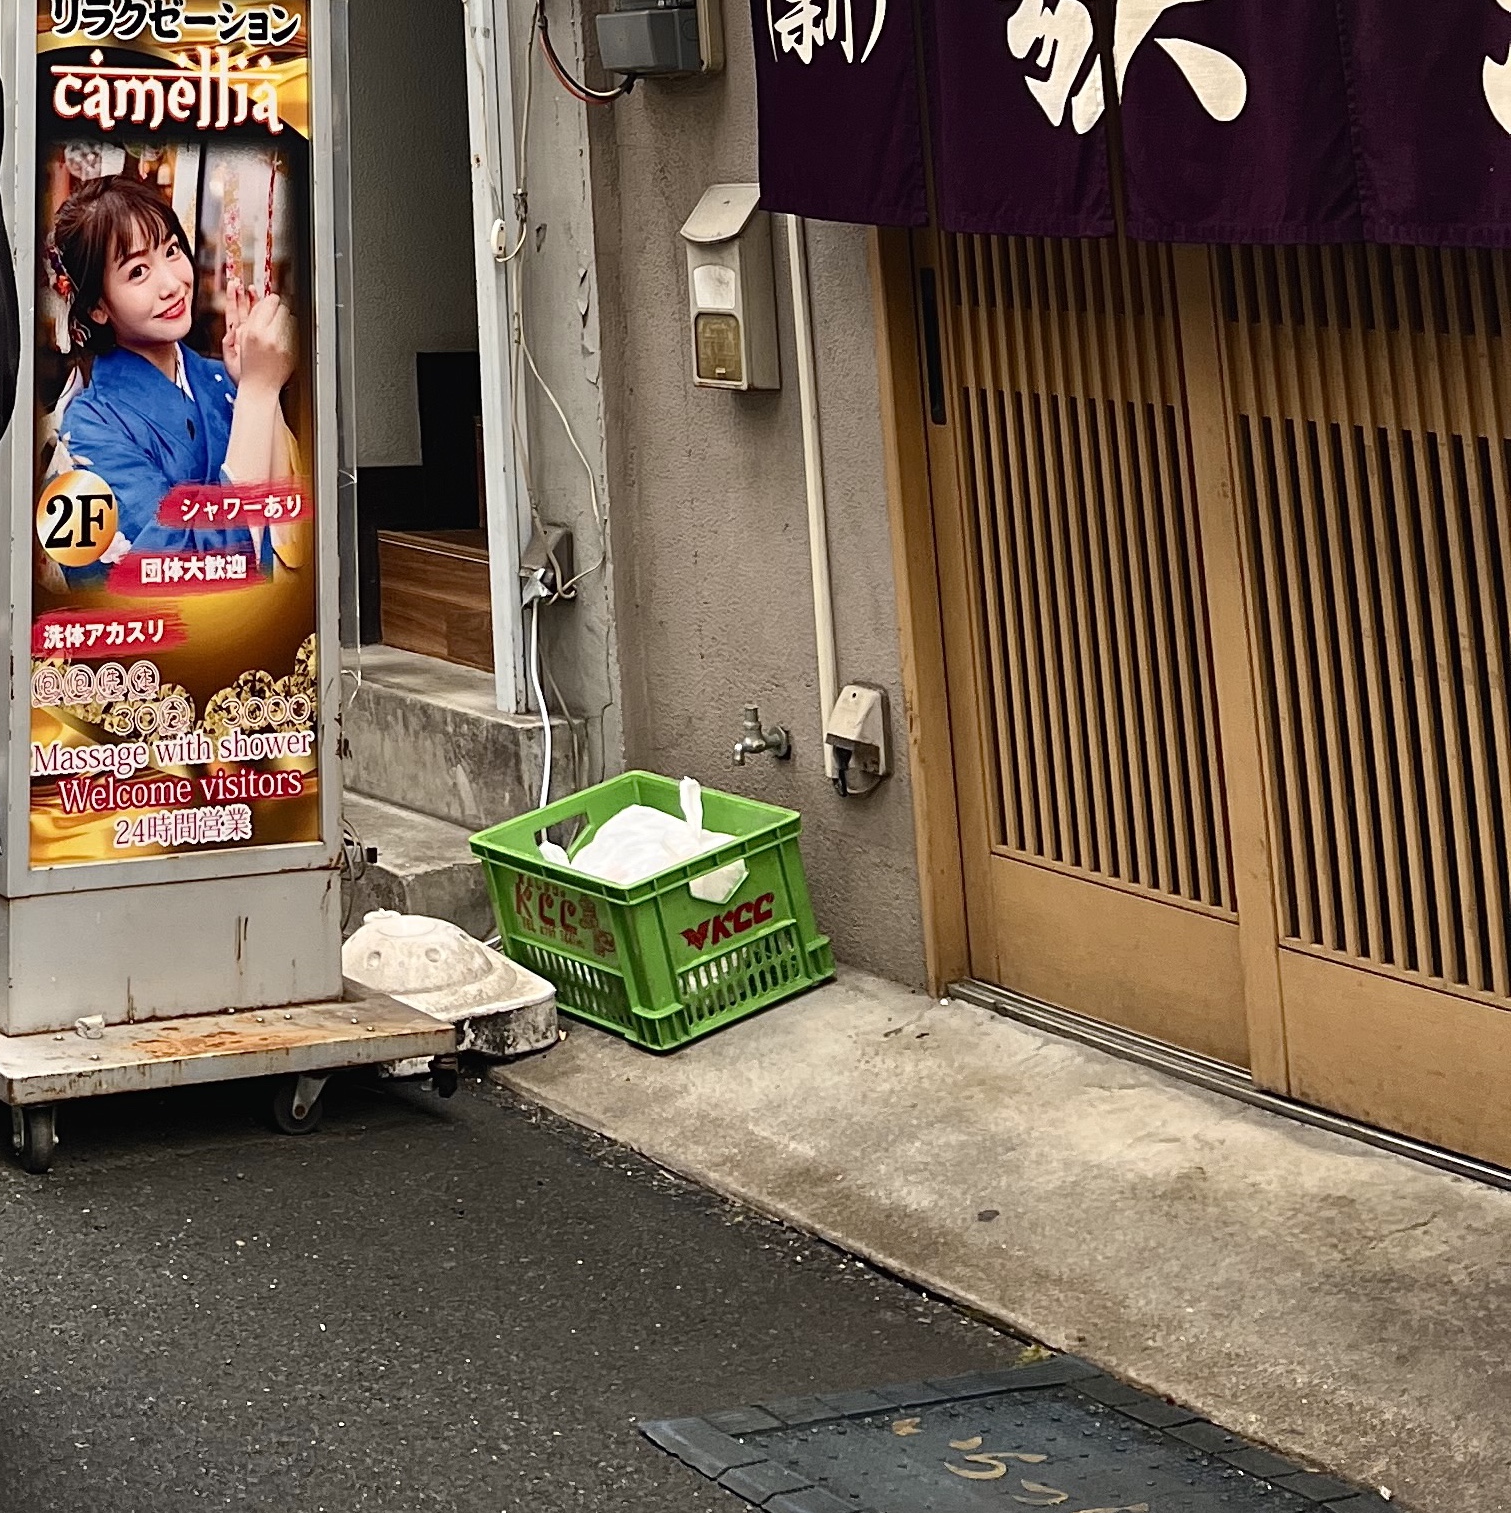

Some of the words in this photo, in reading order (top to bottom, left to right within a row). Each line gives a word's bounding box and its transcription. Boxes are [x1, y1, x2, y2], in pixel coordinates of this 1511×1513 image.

[51, 46, 284, 133] camellia
[44, 493, 114, 549] 2F
[180, 494, 304, 522] シャワーあり
[140, 553, 248, 584] 団体大歓迎
[43, 619, 164, 649] 洗体アカスリ
[114, 696, 190, 735] 30分
[221, 694, 311, 727] 3000
[33, 743, 148, 778] Massage
[154, 734, 213, 765] with
[220, 731, 313, 762] shower
[58, 775, 192, 813] Welcome
[199, 769, 304, 801] visitors
[113, 806, 251, 846] 24時間営業
[515, 882, 578, 936] KCC
